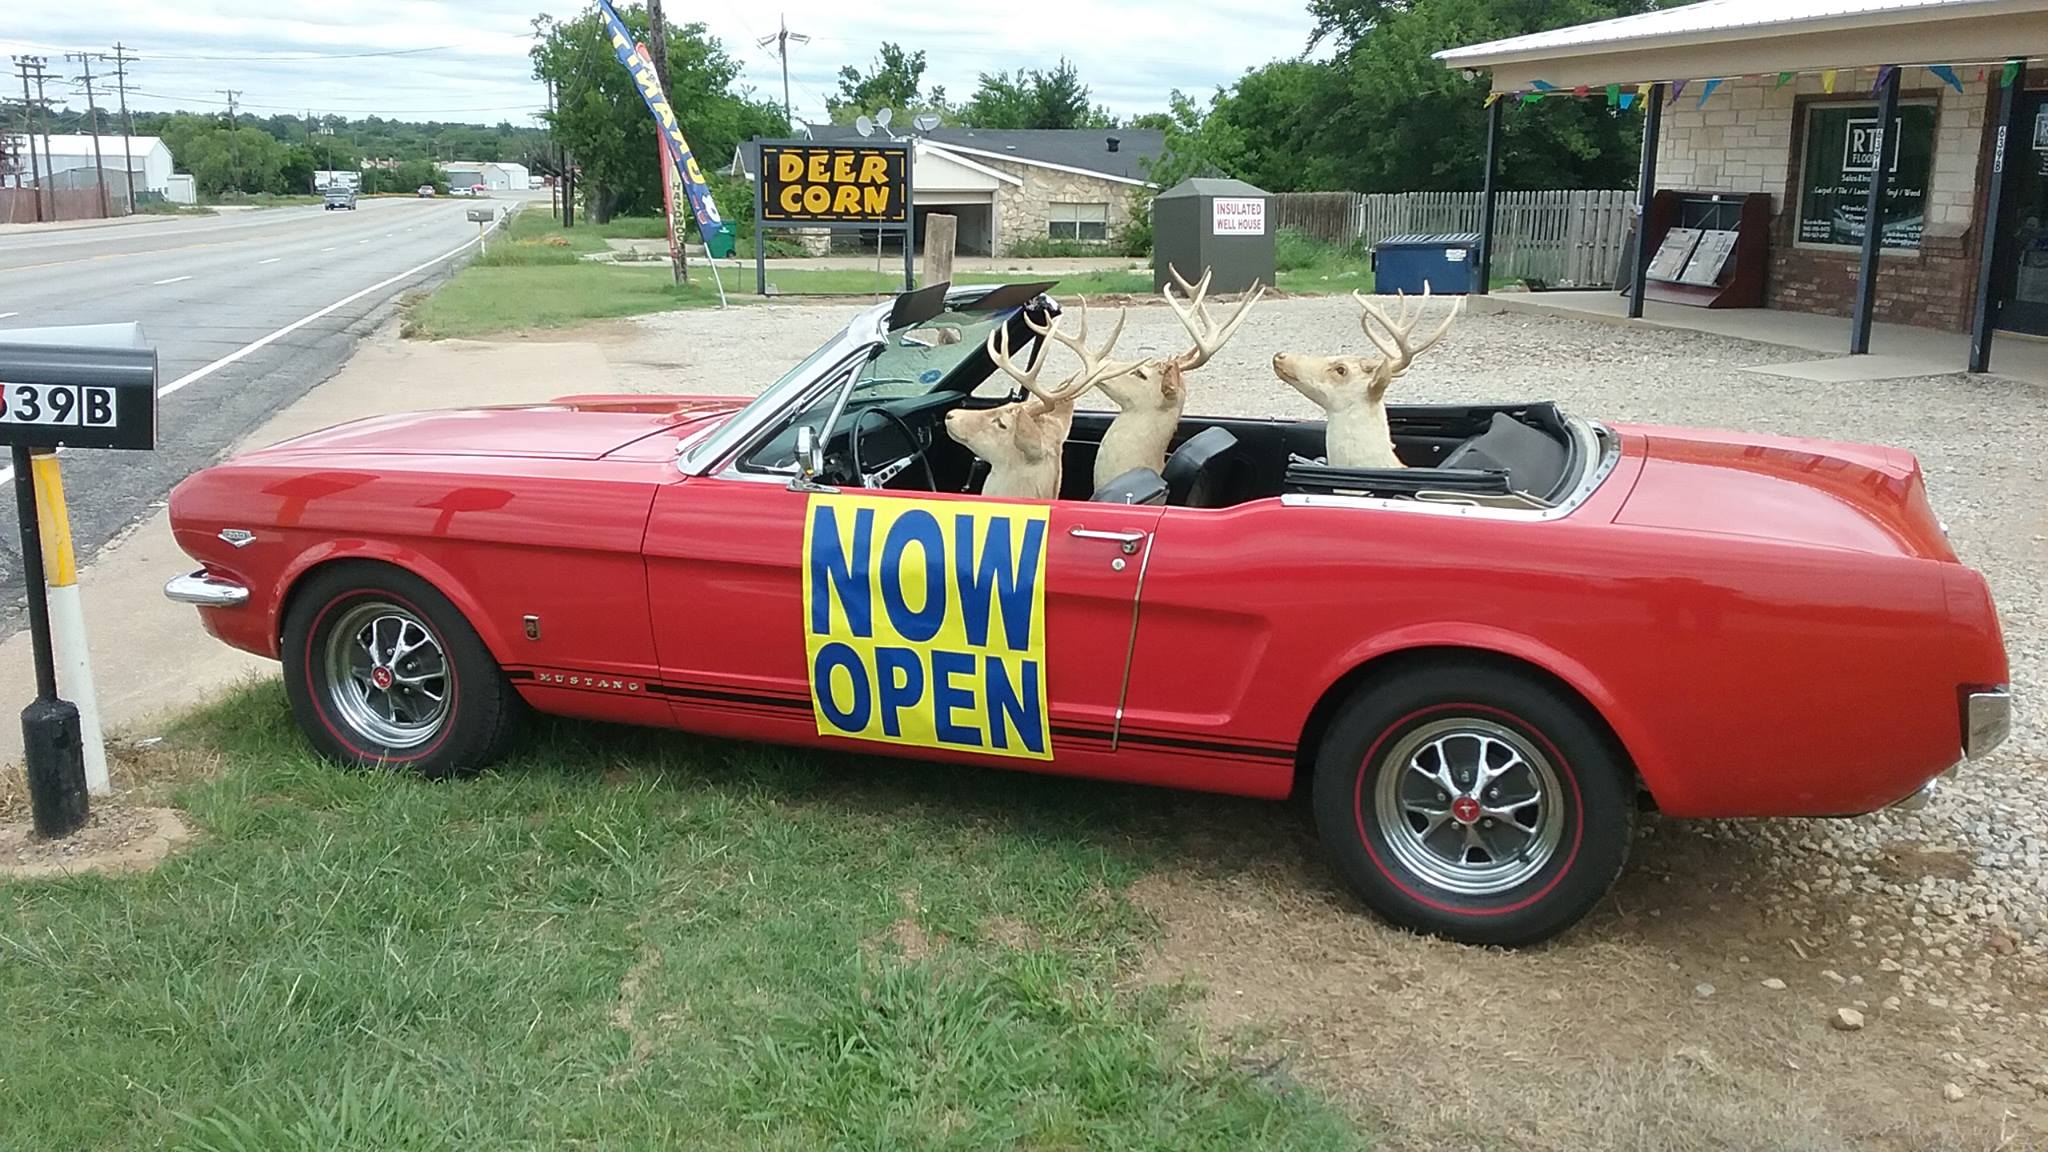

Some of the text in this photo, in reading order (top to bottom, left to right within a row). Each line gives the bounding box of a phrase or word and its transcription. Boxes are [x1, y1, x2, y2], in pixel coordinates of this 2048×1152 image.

[779, 153, 890, 185] DEER
[780, 184, 890, 215] CORN
[1217, 203, 1262, 215] INSULATED
[1217, 218, 1262, 230] WELL HOUSE
[0, 384, 112, 424] 39B
[811, 505, 1047, 652] NOW
[540, 673, 639, 692] MUSTANG
[814, 642, 1046, 754] OPEN
